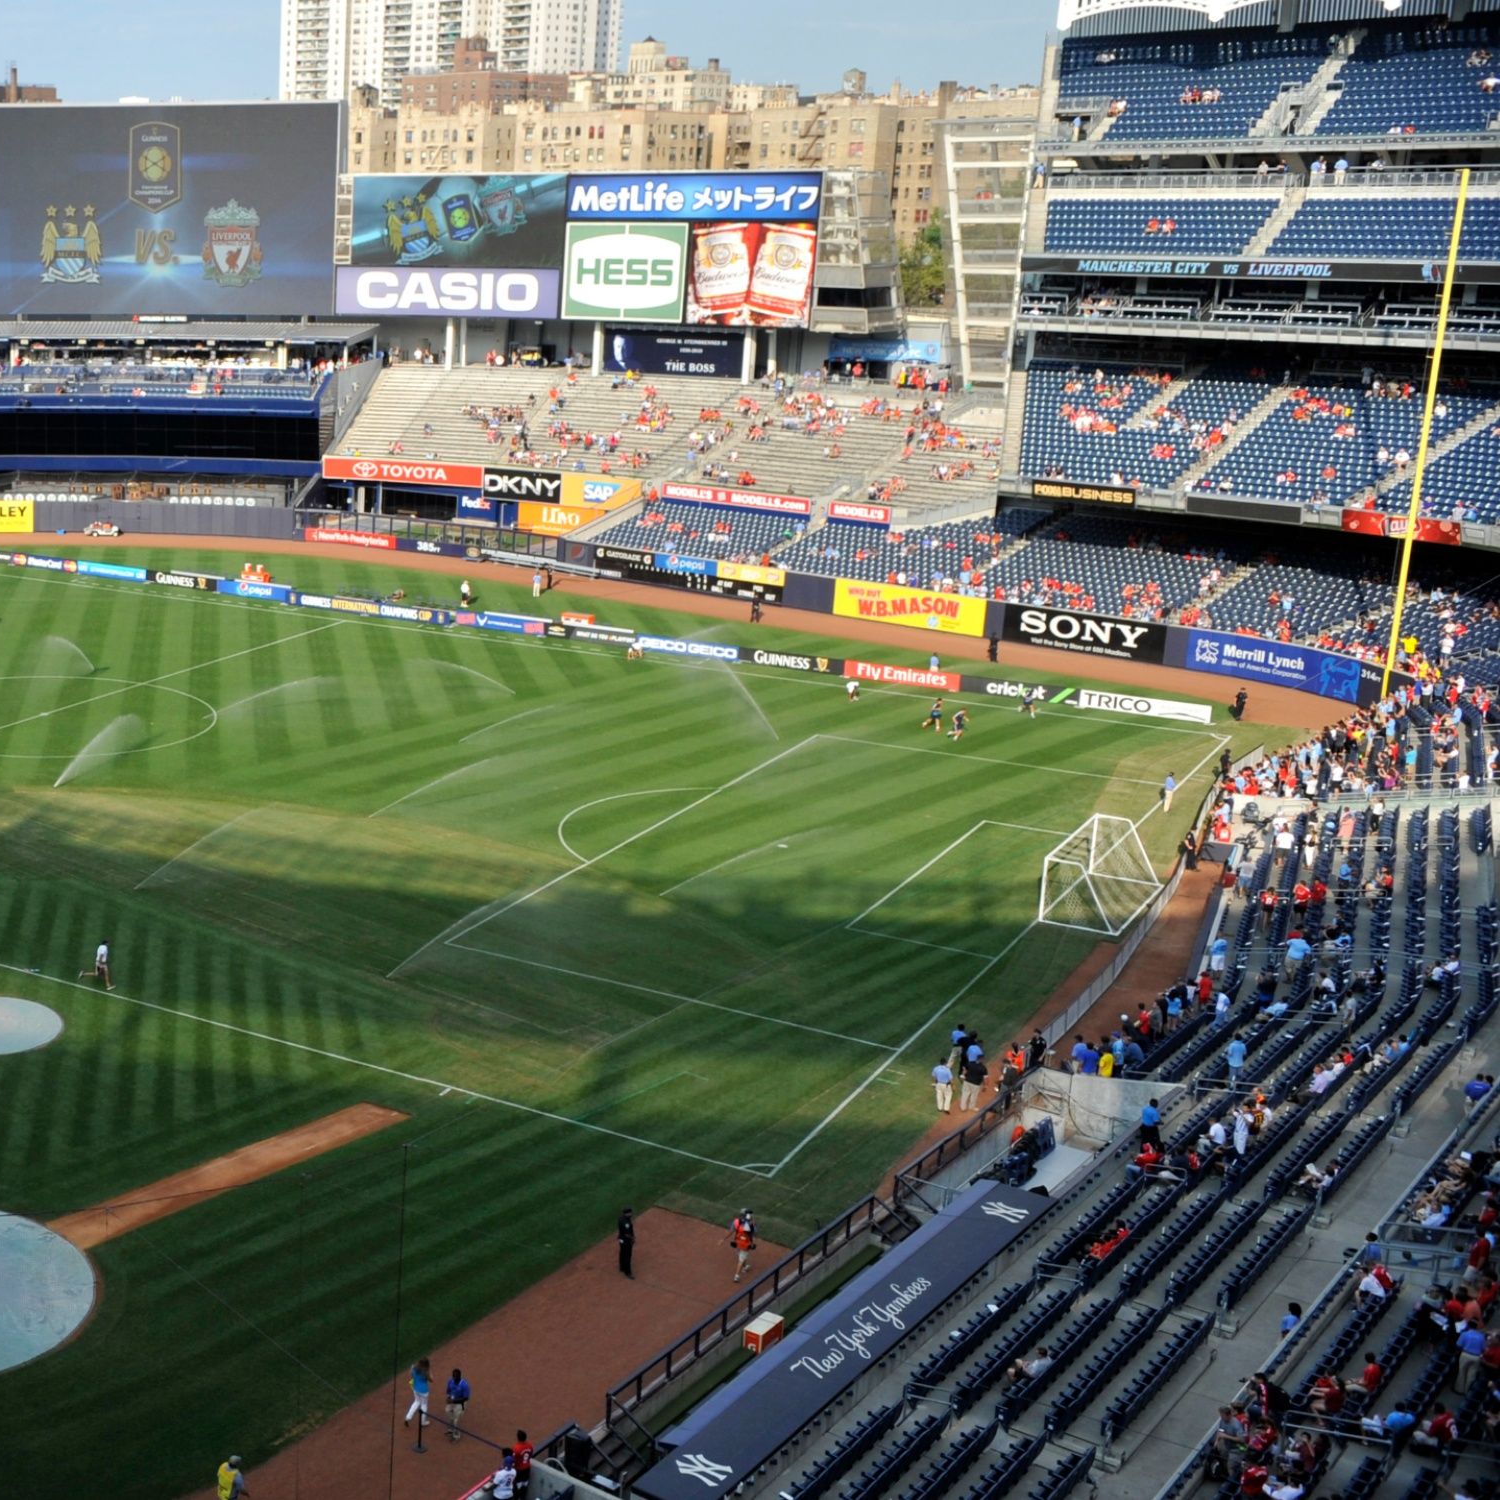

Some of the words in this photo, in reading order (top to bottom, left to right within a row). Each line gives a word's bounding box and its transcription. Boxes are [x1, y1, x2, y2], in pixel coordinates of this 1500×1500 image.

[571, 181, 684, 212] MetLife
[692, 185, 819, 211] メットライフ
[135, 228, 180, 265] VS.
[212, 232, 251, 240] LIVERPOOL
[576, 258, 674, 287] HESS
[1078, 260, 1172, 275] MANCHESTER
[1174, 261, 1210, 275] CITY
[1247, 262, 1332, 278] LIVERPOOL
[355, 271, 539, 311] CASIO
[664, 361, 686, 372] THE
[688, 362, 716, 373] BOSS
[380, 464, 447, 480] TOYOTA
[484, 474, 561, 497] DKNY
[583, 484, 614, 500] SAP
[1062, 487, 1133, 504] BUSINESS
[462, 496, 491, 510] FedEx
[666, 486, 713, 500] MODELL'S
[730, 490, 806, 510] MODELLS.com
[834, 504, 885, 520] MODELL'S
[606, 551, 641, 562] GATORADE
[680, 560, 705, 572] pepsi
[156, 572, 194, 588] GUINNESS
[248, 586, 272, 597] pepsi
[300, 594, 331, 608] GUINNESS
[331, 598, 380, 615] INTERNATIONAL
[380, 604, 418, 620] CHAMPIONS
[419, 609, 432, 622] CUP
[1020, 610, 1149, 649] SONY
[639, 634, 686, 652] GEICO
[688, 642, 738, 659] GEICO
[754, 650, 810, 670] GUINNESS
[1224, 644, 1266, 664] Merrill
[1268, 652, 1305, 671] Lynch
[856, 662, 880, 680] Fly
[883, 665, 948, 686] Emirates
[1222, 658, 1238, 668] Bank
[1239, 661, 1246, 670] of
[1247, 662, 1272, 675] America
[1272, 667, 1307, 680] Corporation
[986, 680, 1045, 700] cricket
[1084, 692, 1152, 713] TRICO
[790, 1348, 844, 1379] New
[824, 1314, 880, 1360] York
[858, 1276, 932, 1330] Yankees
